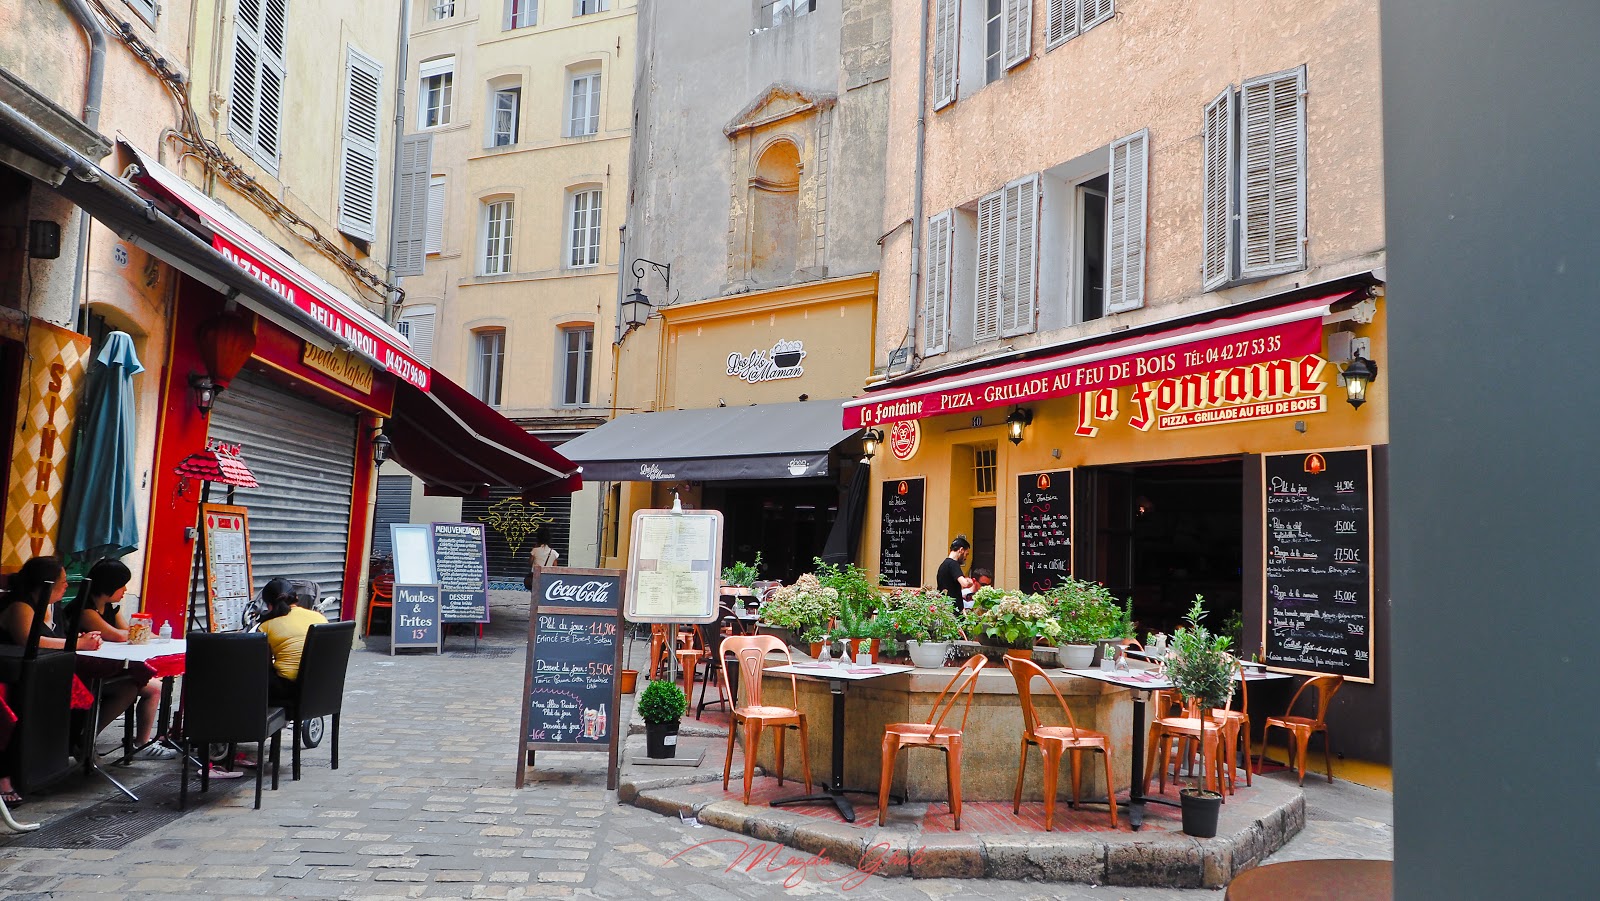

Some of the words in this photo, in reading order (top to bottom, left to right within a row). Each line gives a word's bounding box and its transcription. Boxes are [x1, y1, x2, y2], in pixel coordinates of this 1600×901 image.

[310, 302, 342, 337] BELLA
[345, 323, 378, 358] NAPOLI
[385, 348, 396, 368] 04
[394, 355, 404, 373] 42
[402, 359, 412, 379] 27
[410, 363, 420, 382] 96
[418, 369, 427, 388] 80
[337, 354, 373, 389] Napoli
[759, 362, 802, 380] Maman
[860, 406, 873, 427] La
[1051, 373, 1072, 391] AU
[1108, 361, 1131, 381] DE
[1135, 353, 1177, 378] BOIS
[1205, 347, 1219, 364] 04
[1220, 345, 1234, 361] 42
[1235, 342, 1250, 358] 27
[1251, 339, 1265, 355] 53
[1266, 335, 1282, 353] 35
[1075, 387, 1120, 438] La
[1162, 413, 1188, 427] PIZZA
[1194, 407, 1239, 423] GRILLADE
[1239, 405, 1254, 418] AU
[1255, 402, 1275, 415] FEU
[1275, 401, 1290, 413] DE
[1290, 397, 1318, 411] BOIS
[41, 362, 65, 493] SINH
[435, 525, 453, 534] MENU
[397, 590, 435, 603] Moules
[449, 593, 474, 601] DESSERT
[412, 604, 422, 613] &
[399, 614, 433, 627] Frites
[559, 618, 568, 630] du
[561, 661, 570, 672] du
[588, 662, 614, 676] 5,50€
